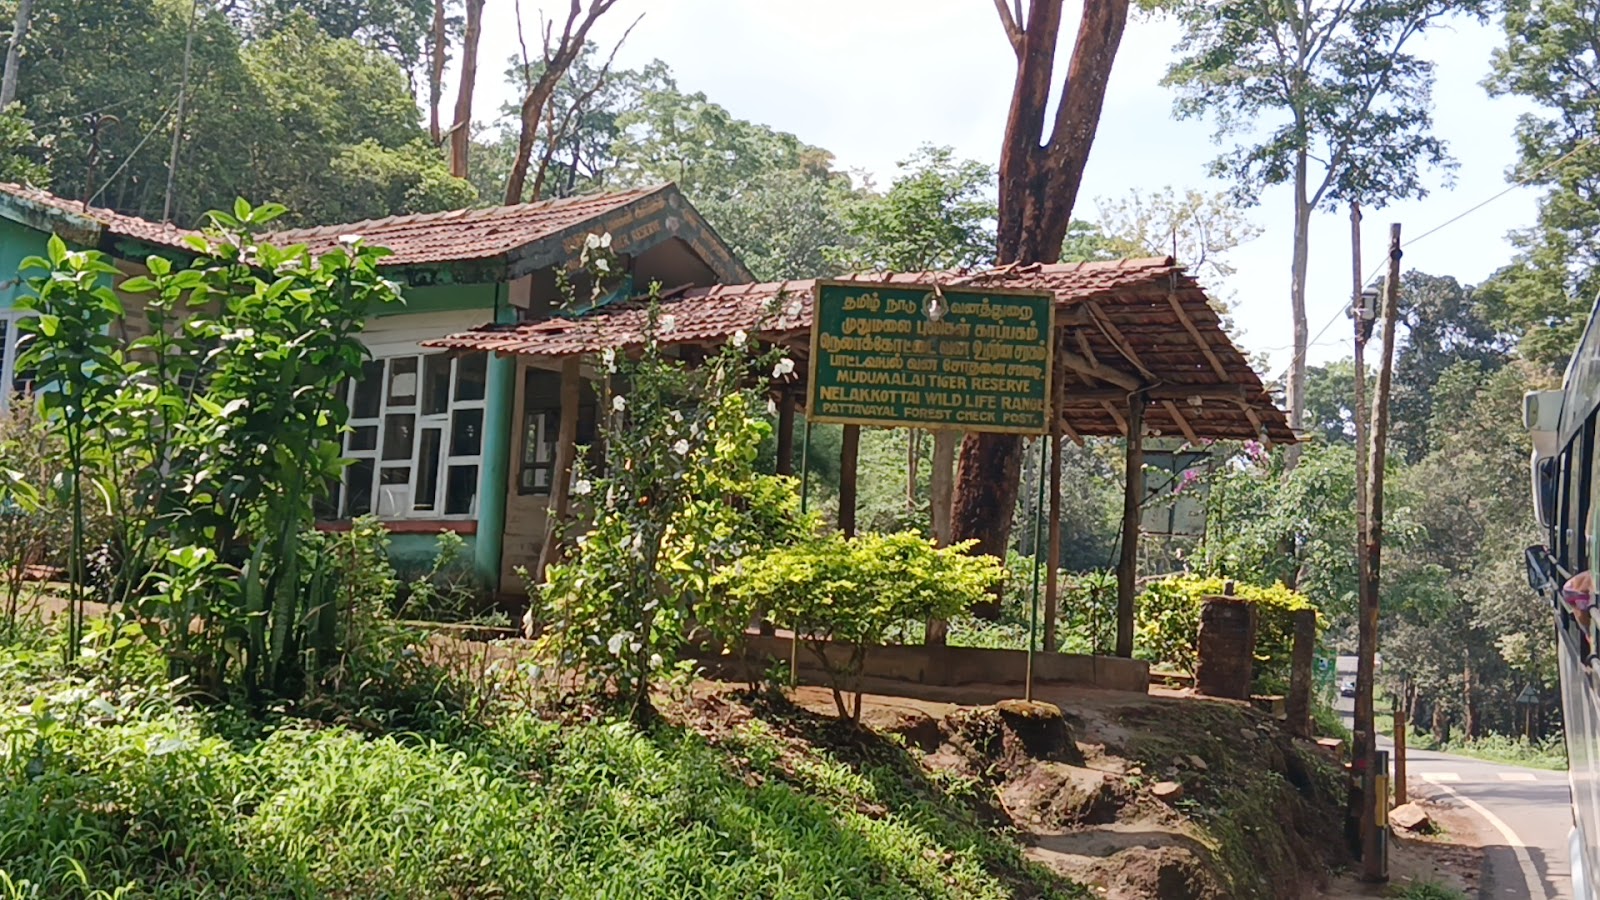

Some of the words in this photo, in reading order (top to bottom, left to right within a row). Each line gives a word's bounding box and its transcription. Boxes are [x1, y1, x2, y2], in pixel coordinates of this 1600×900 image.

[842, 292, 881, 312] தமிழ்
[885, 298, 916, 314] நாடு
[951, 297, 1033, 320] வனத்துறை
[842, 317, 912, 336] முதுமலை
[917, 316, 971, 337] புலிகள்
[974, 319, 1038, 341] காப்பகம்
[906, 358, 938, 372] வன
[943, 358, 1006, 375] சோதனை
[836, 369, 925, 387] MUDUMALAI
[928, 374, 967, 390] TIGER
[971, 377, 1031, 393] RESERVE
[819, 385, 920, 405] NELAKKOTTAI
[924, 390, 962, 407] WILD
[965, 394, 997, 410] LIFE
[823, 402, 898, 417] PATTAVAYAL
[903, 406, 952, 421] FOREST
[955, 409, 996, 423] CHECK
